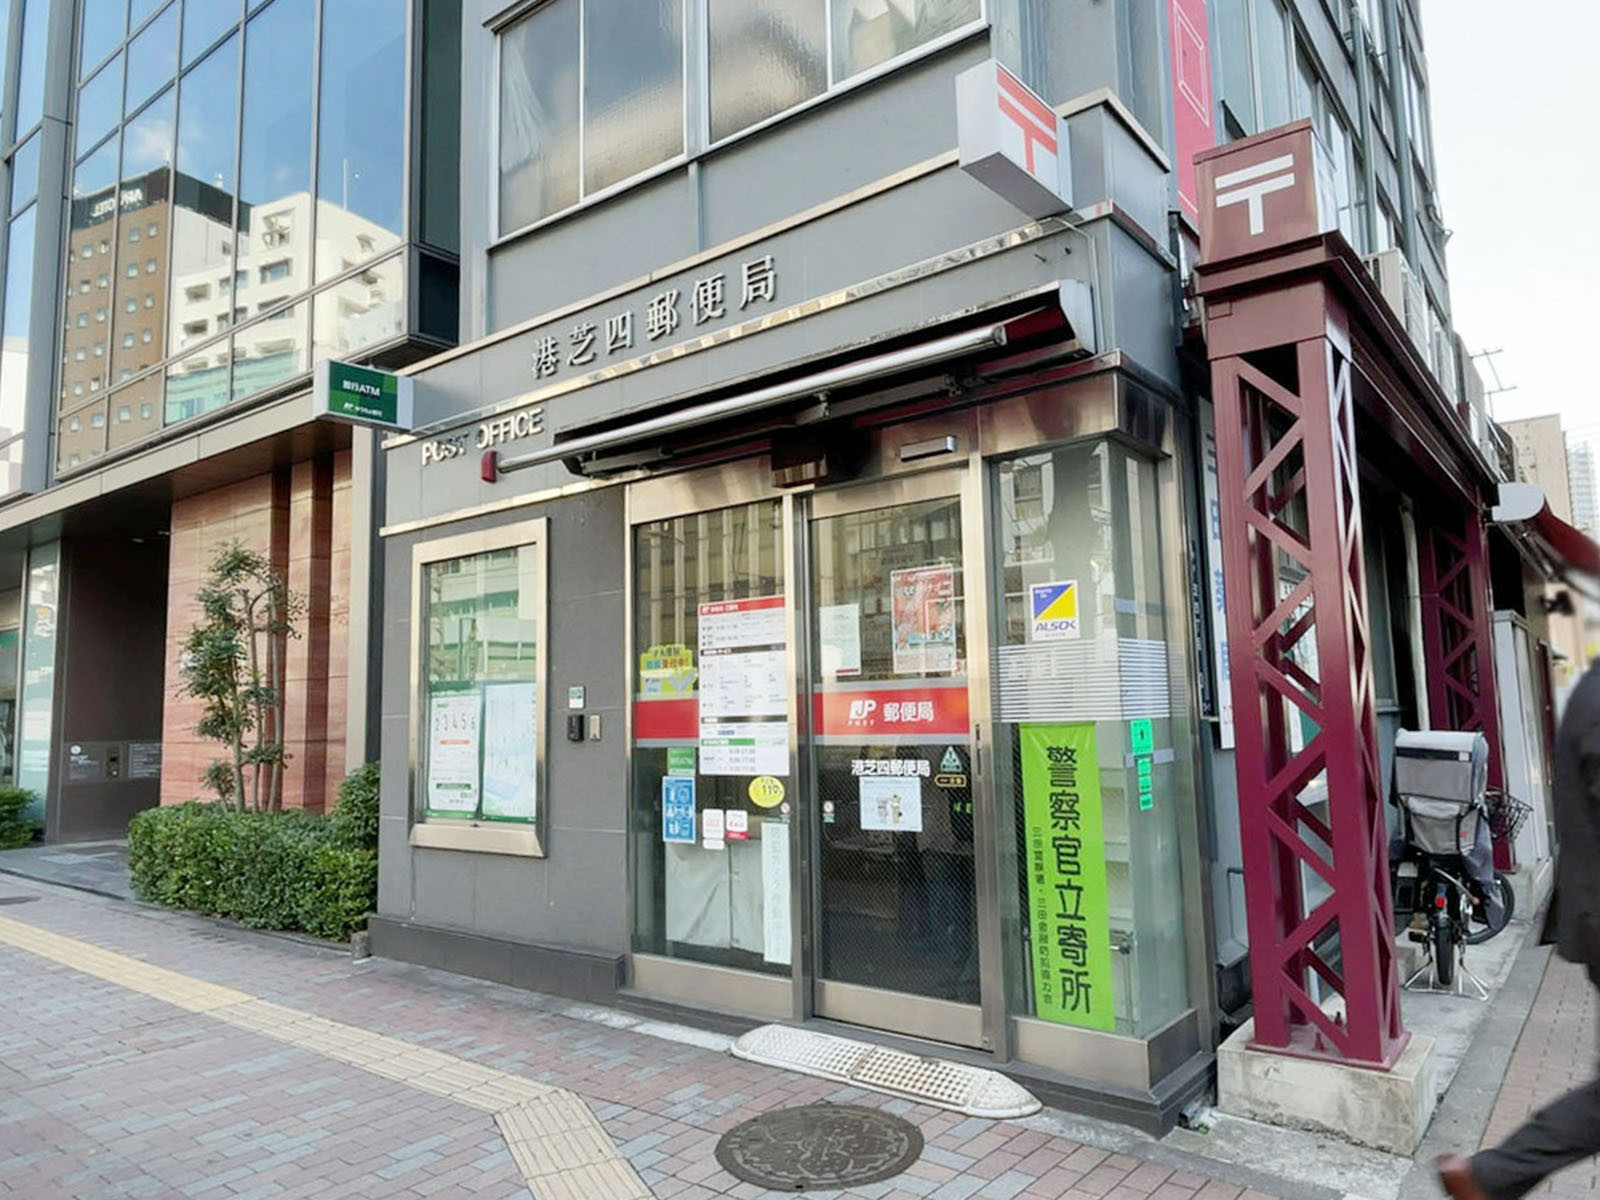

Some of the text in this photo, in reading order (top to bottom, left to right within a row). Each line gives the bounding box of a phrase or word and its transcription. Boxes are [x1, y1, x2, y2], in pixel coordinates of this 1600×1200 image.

[531, 255, 777, 378] 港芝四郵便局
[476, 407, 544, 449] OFFICE
[1036, 620, 1076, 632] ALSOK
[883, 700, 934, 723] 郵便局
[851, 759, 931, 777] 港芝四郵便局
[1045, 745, 1092, 1014] 警察官立寄所
